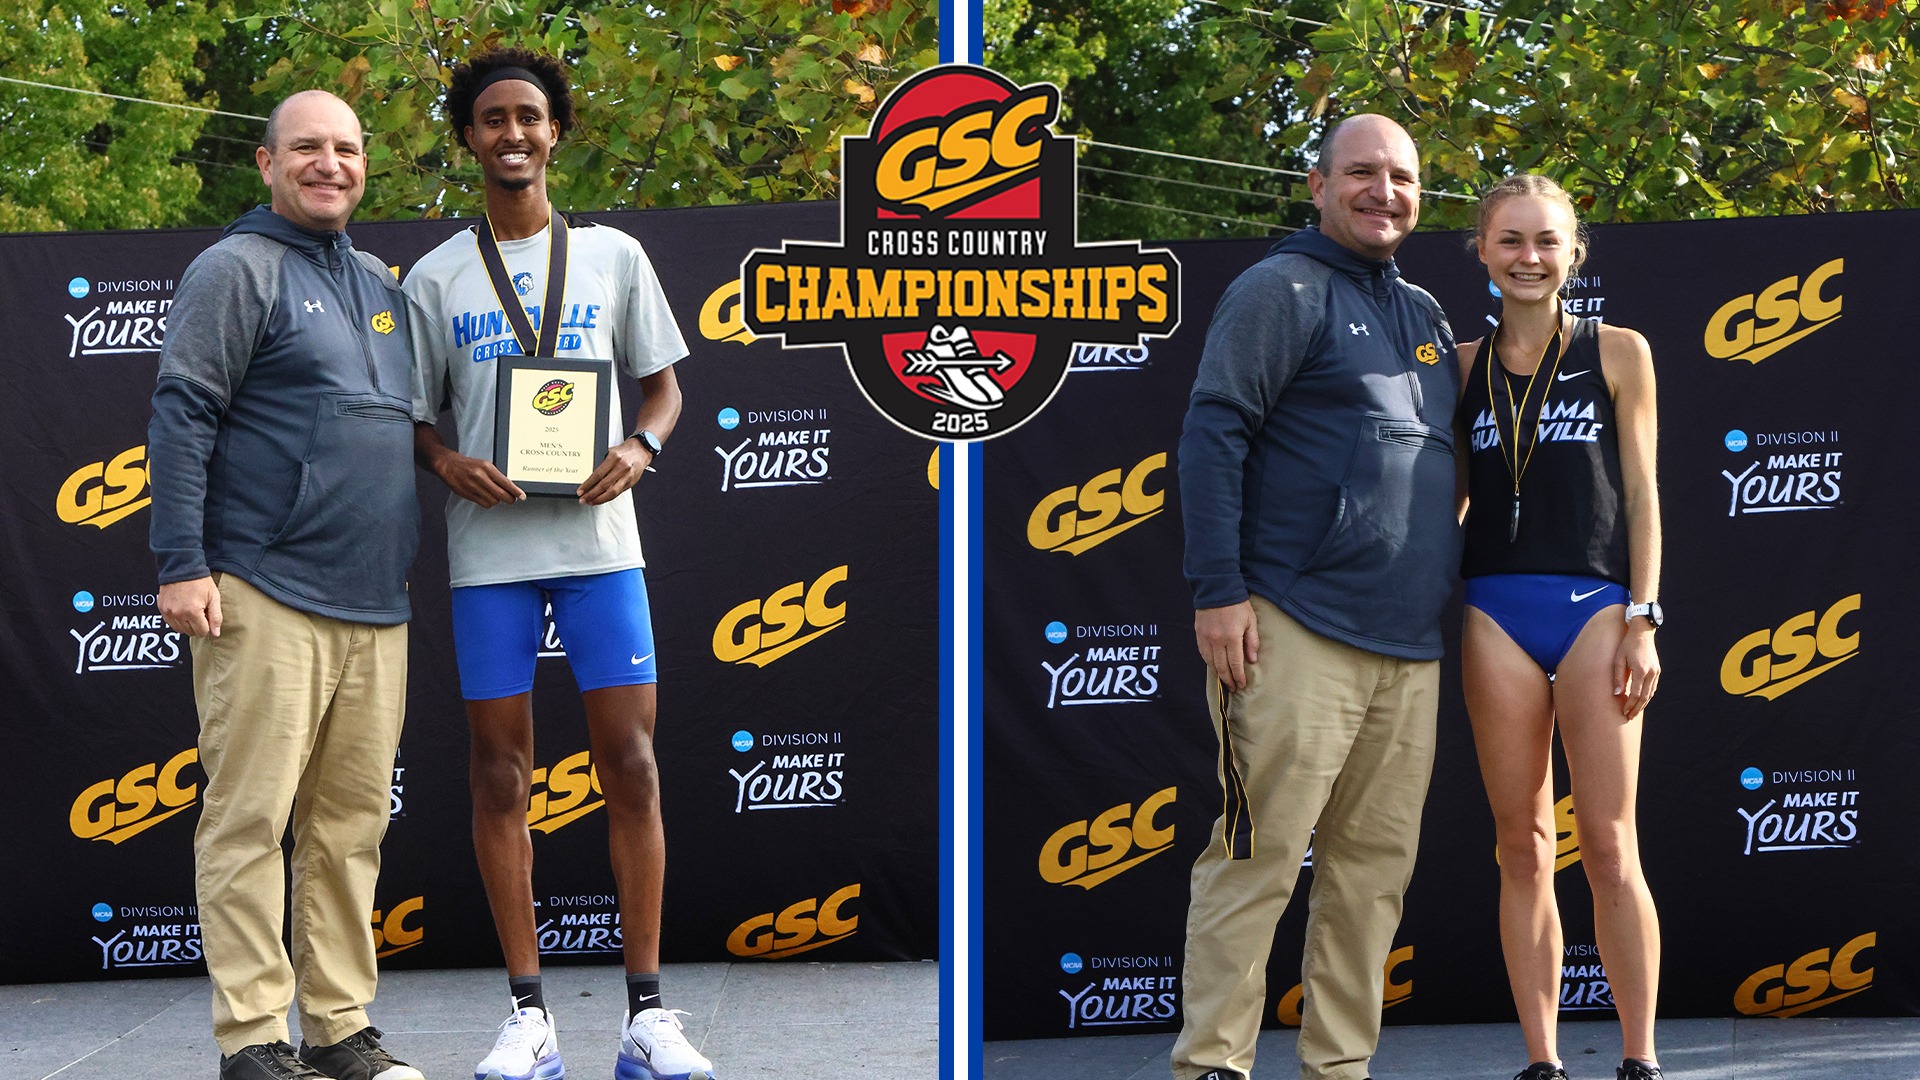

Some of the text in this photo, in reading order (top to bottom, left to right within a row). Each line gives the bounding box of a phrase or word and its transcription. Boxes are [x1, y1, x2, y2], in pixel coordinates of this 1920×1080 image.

[98, 280, 160, 293] DIVISION
[165, 279, 173, 290] II
[106, 300, 156, 315] MAKE
[1587, 297, 1605, 312] IT
[1704, 257, 1844, 361] GSC
[476, 341, 514, 361] CROSS
[532, 383, 574, 410] GSC
[748, 409, 814, 424] DIVISION
[820, 408, 827, 420] II
[758, 430, 831, 446] MAKE IT
[1757, 431, 1825, 446] DIVISION
[1831, 431, 1838, 442] II
[520, 448, 581, 458] CROSS COUNTRY
[1767, 452, 1843, 470] MAKE IT
[522, 465, 578, 474] Runner of the Year
[714, 438, 829, 492] YOURS
[55, 446, 151, 524] GS
[1722, 461, 1841, 517] YOURS
[1027, 451, 1167, 553] GSC
[102, 594, 159, 607] DIVISIO
[112, 615, 162, 630] MAKE
[712, 564, 849, 665] GSC
[1076, 624, 1144, 638] DIVISION
[1150, 624, 1157, 636] II
[70, 621, 180, 674] YOURS
[1719, 593, 1861, 698] GSC
[1086, 646, 1161, 662] MAKE IT
[1041, 653, 1159, 709] YOURS
[762, 733, 828, 747] DIVISION
[833, 732, 841, 744] II
[772, 753, 845, 769] MAKE IT
[1773, 769, 1842, 784] DIVISION
[1848, 769, 1855, 781] II
[68, 747, 198, 842] GSC
[728, 760, 844, 813] YOURS
[1783, 791, 1860, 808] MAKE IT
[1737, 799, 1858, 855] YOURS
[1038, 786, 1177, 887] GSC
[550, 895, 615, 907] DIVISION
[121, 906, 184, 917] DIVISION
[189, 906, 197, 916] II
[560, 913, 612, 926] MAKE
[726, 883, 862, 958] GSC
[133, 924, 182, 937] MAKE
[91, 929, 202, 969] YOURS
[1091, 956, 1158, 968] DIVISION
[1164, 956, 1172, 967] II
[1734, 932, 1876, 1017] GSC
[1102, 976, 1176, 990] MAKE IT
[1059, 982, 1176, 1028] YOURS
